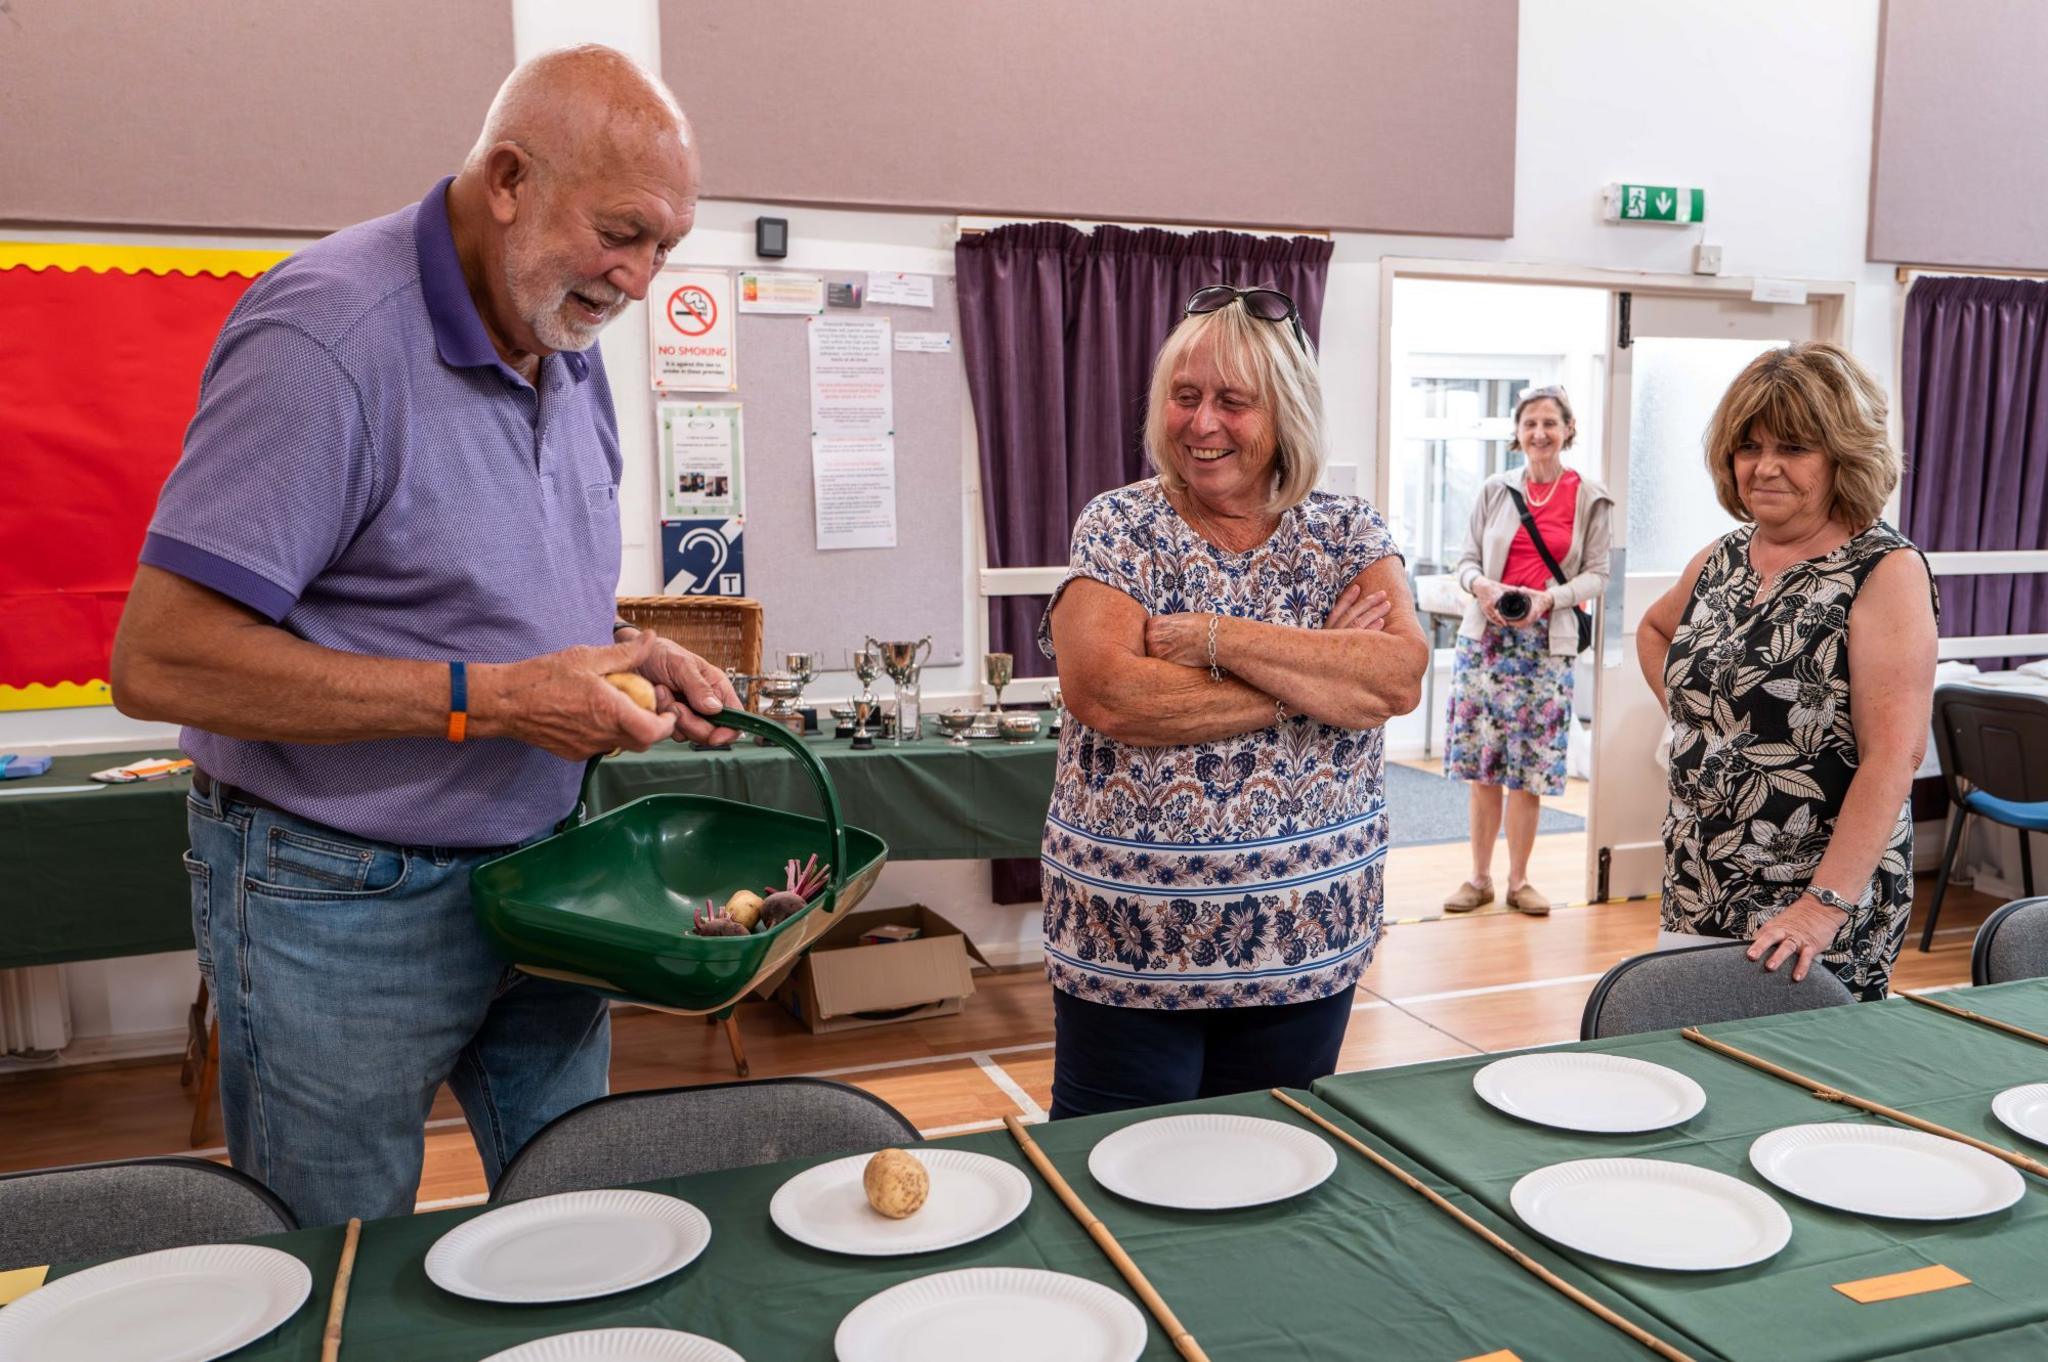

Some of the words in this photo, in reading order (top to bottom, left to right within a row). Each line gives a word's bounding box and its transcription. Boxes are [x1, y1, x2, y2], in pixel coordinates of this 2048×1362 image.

[658, 346, 676, 356] NO
[678, 346, 727, 357] SMOKING
[723, 575, 738, 593] T
